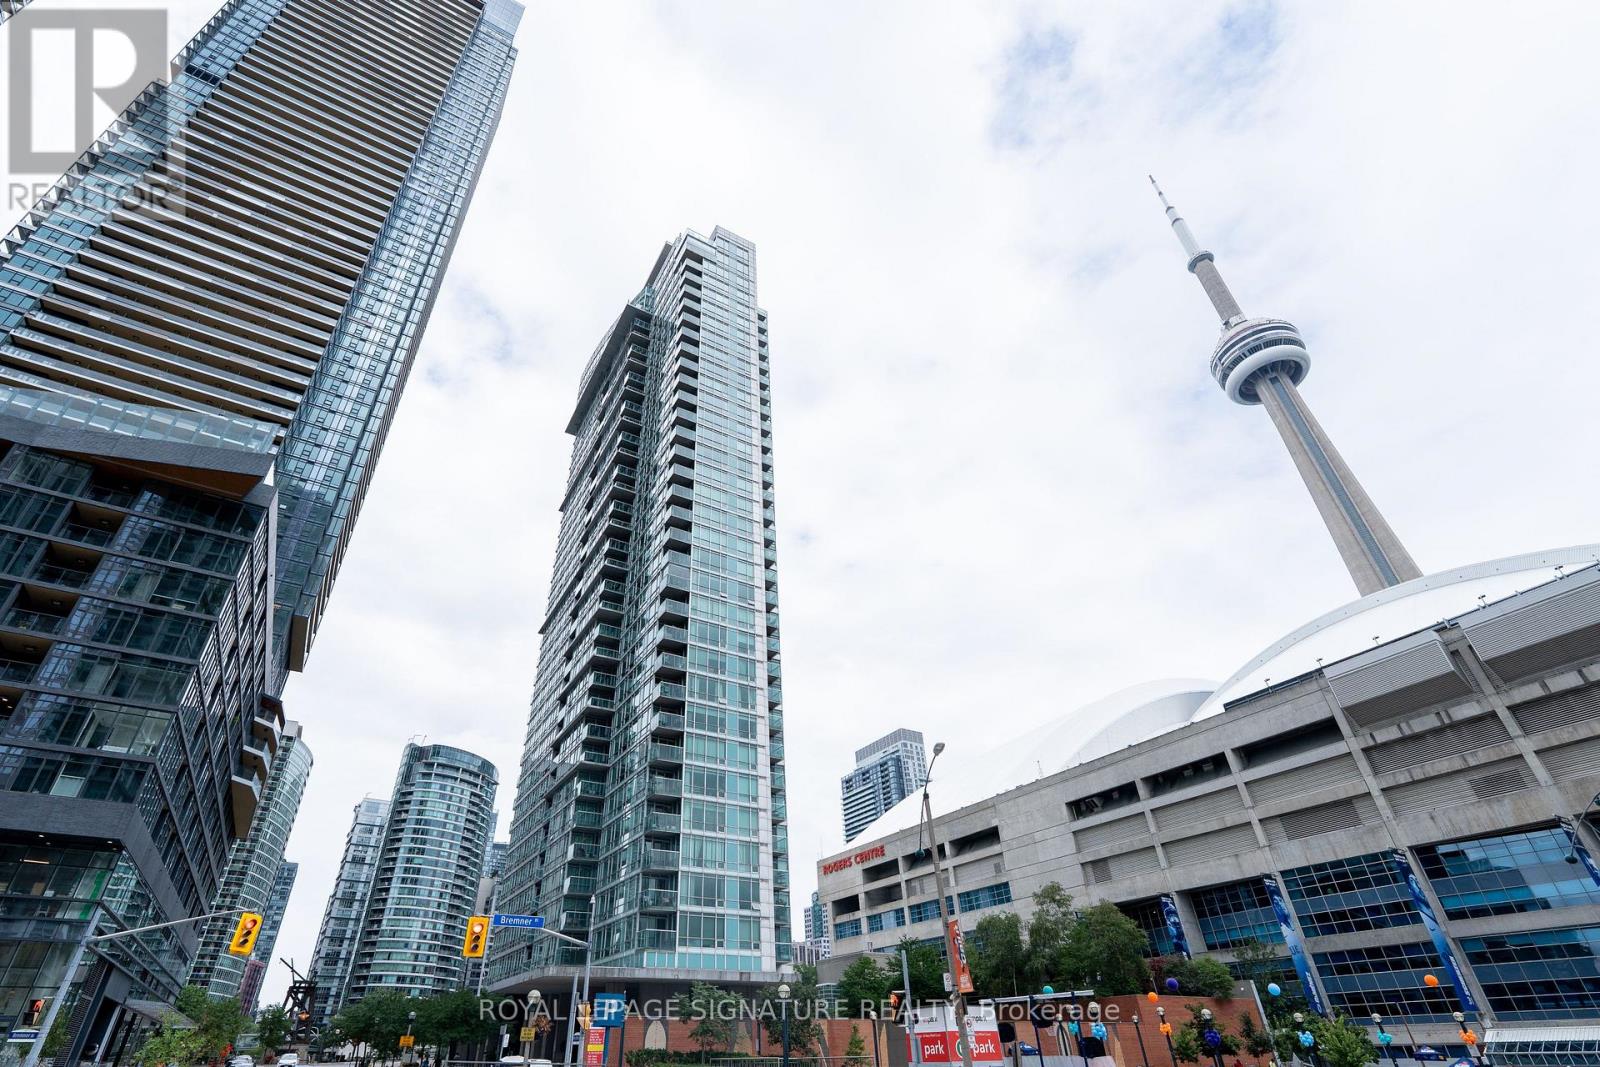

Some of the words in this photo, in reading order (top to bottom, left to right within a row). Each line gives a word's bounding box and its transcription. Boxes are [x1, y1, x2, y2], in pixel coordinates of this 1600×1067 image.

[822, 856, 853, 876] ROGERS
[854, 843, 886, 865] CENTRE
[500, 915, 533, 926] Bremner
[924, 1040, 945, 1058] park
[973, 1039, 996, 1058] park
